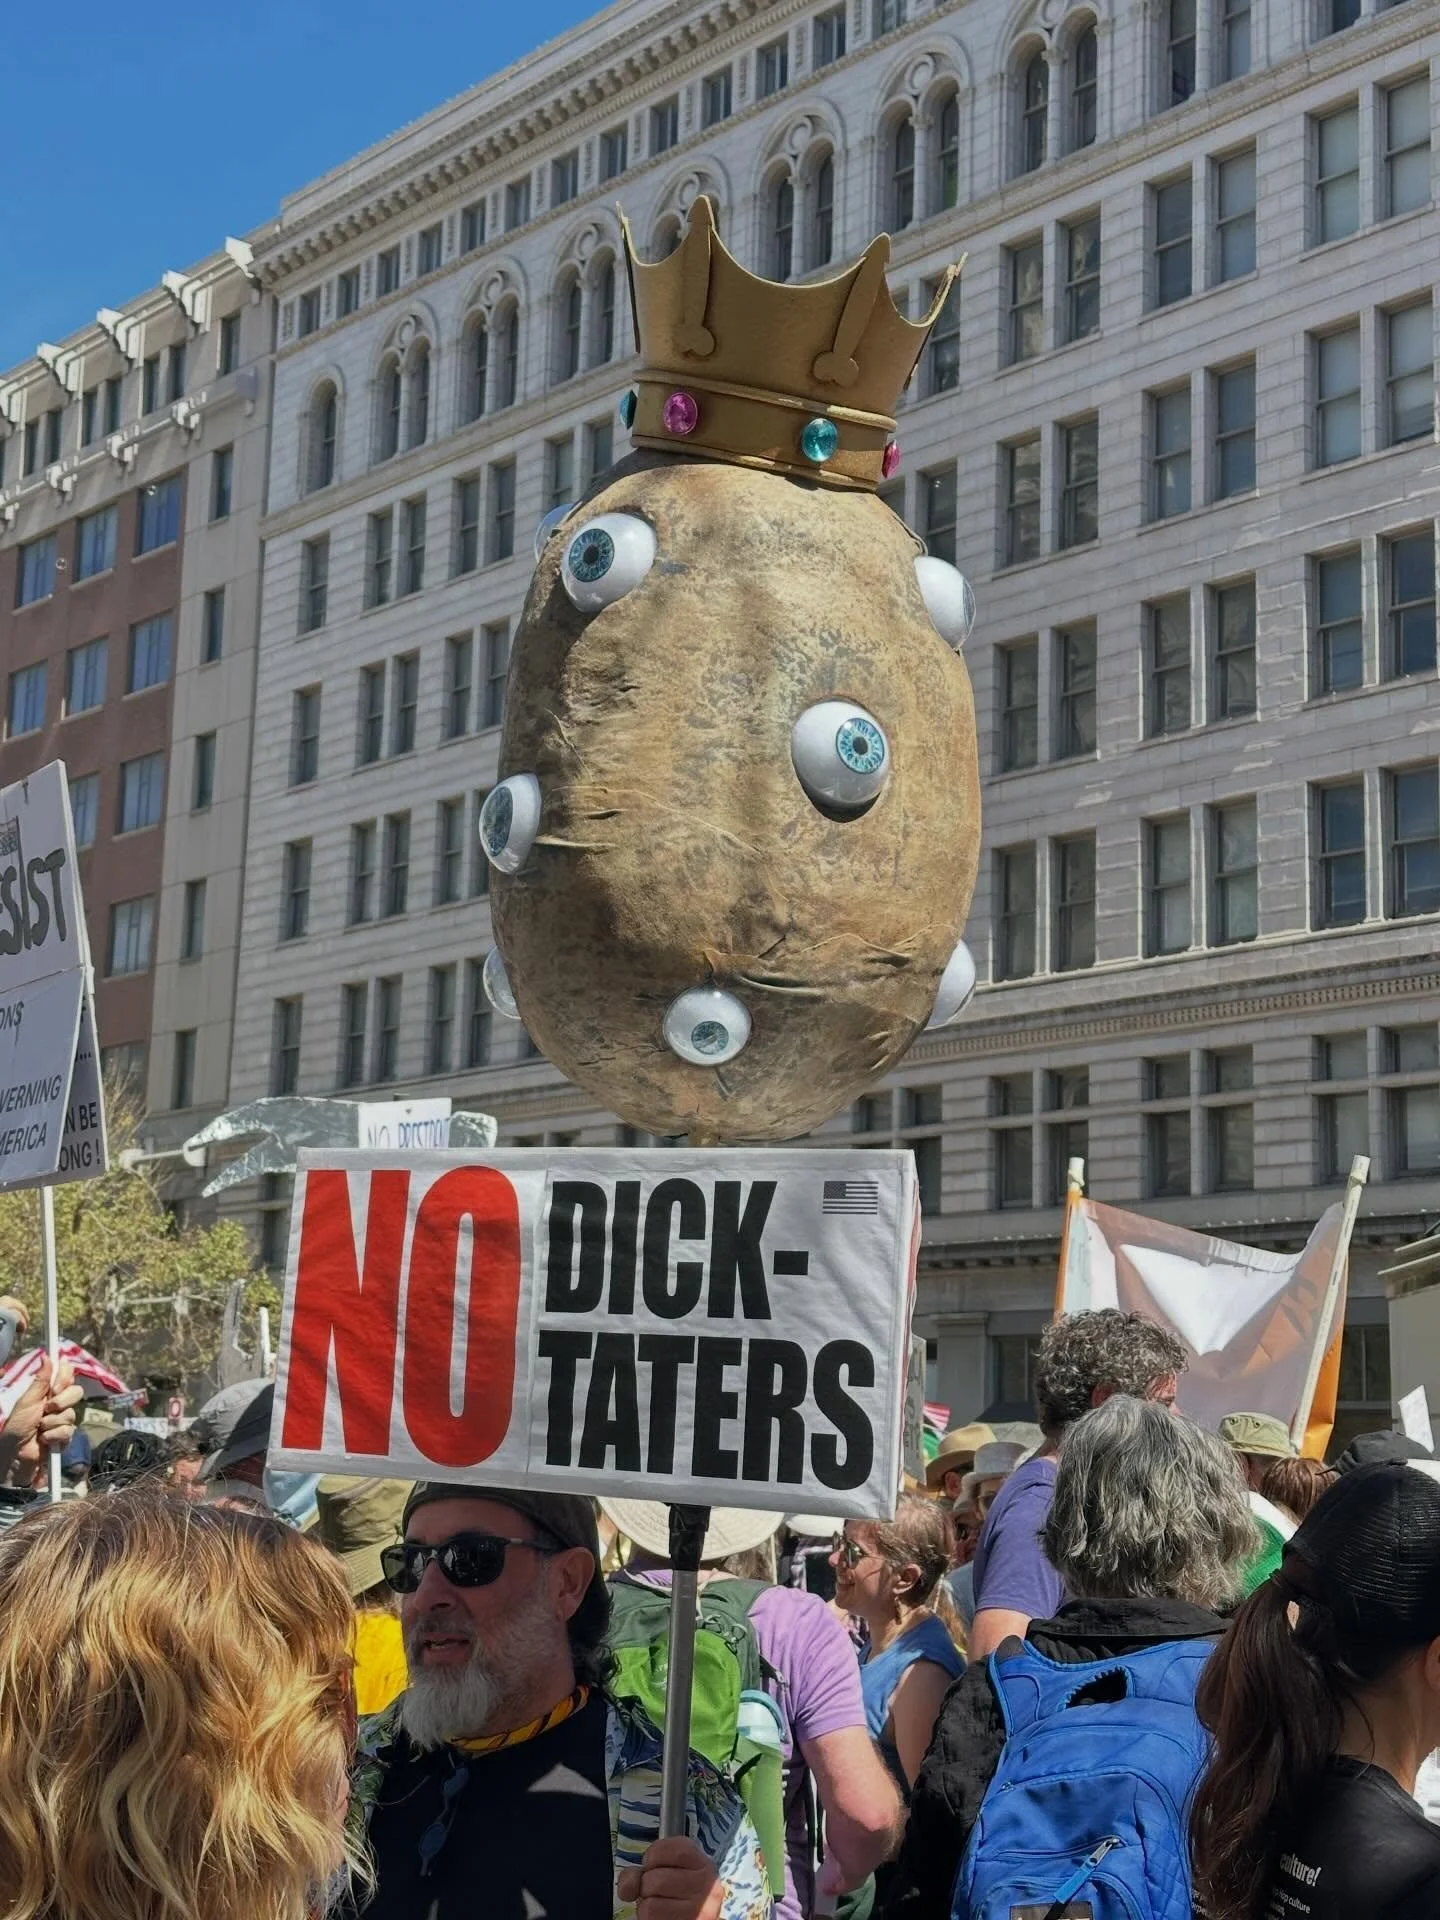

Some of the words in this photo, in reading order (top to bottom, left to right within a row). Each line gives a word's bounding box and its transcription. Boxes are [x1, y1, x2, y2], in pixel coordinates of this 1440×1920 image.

[0, 847, 66, 955] SIST
[79, 1101, 98, 1131] BE
[545, 1178, 809, 1320] DICK-
[281, 1165, 521, 1467] NO
[538, 1330, 875, 1490] TATERS
[1280, 1853, 1322, 1887] culture!
